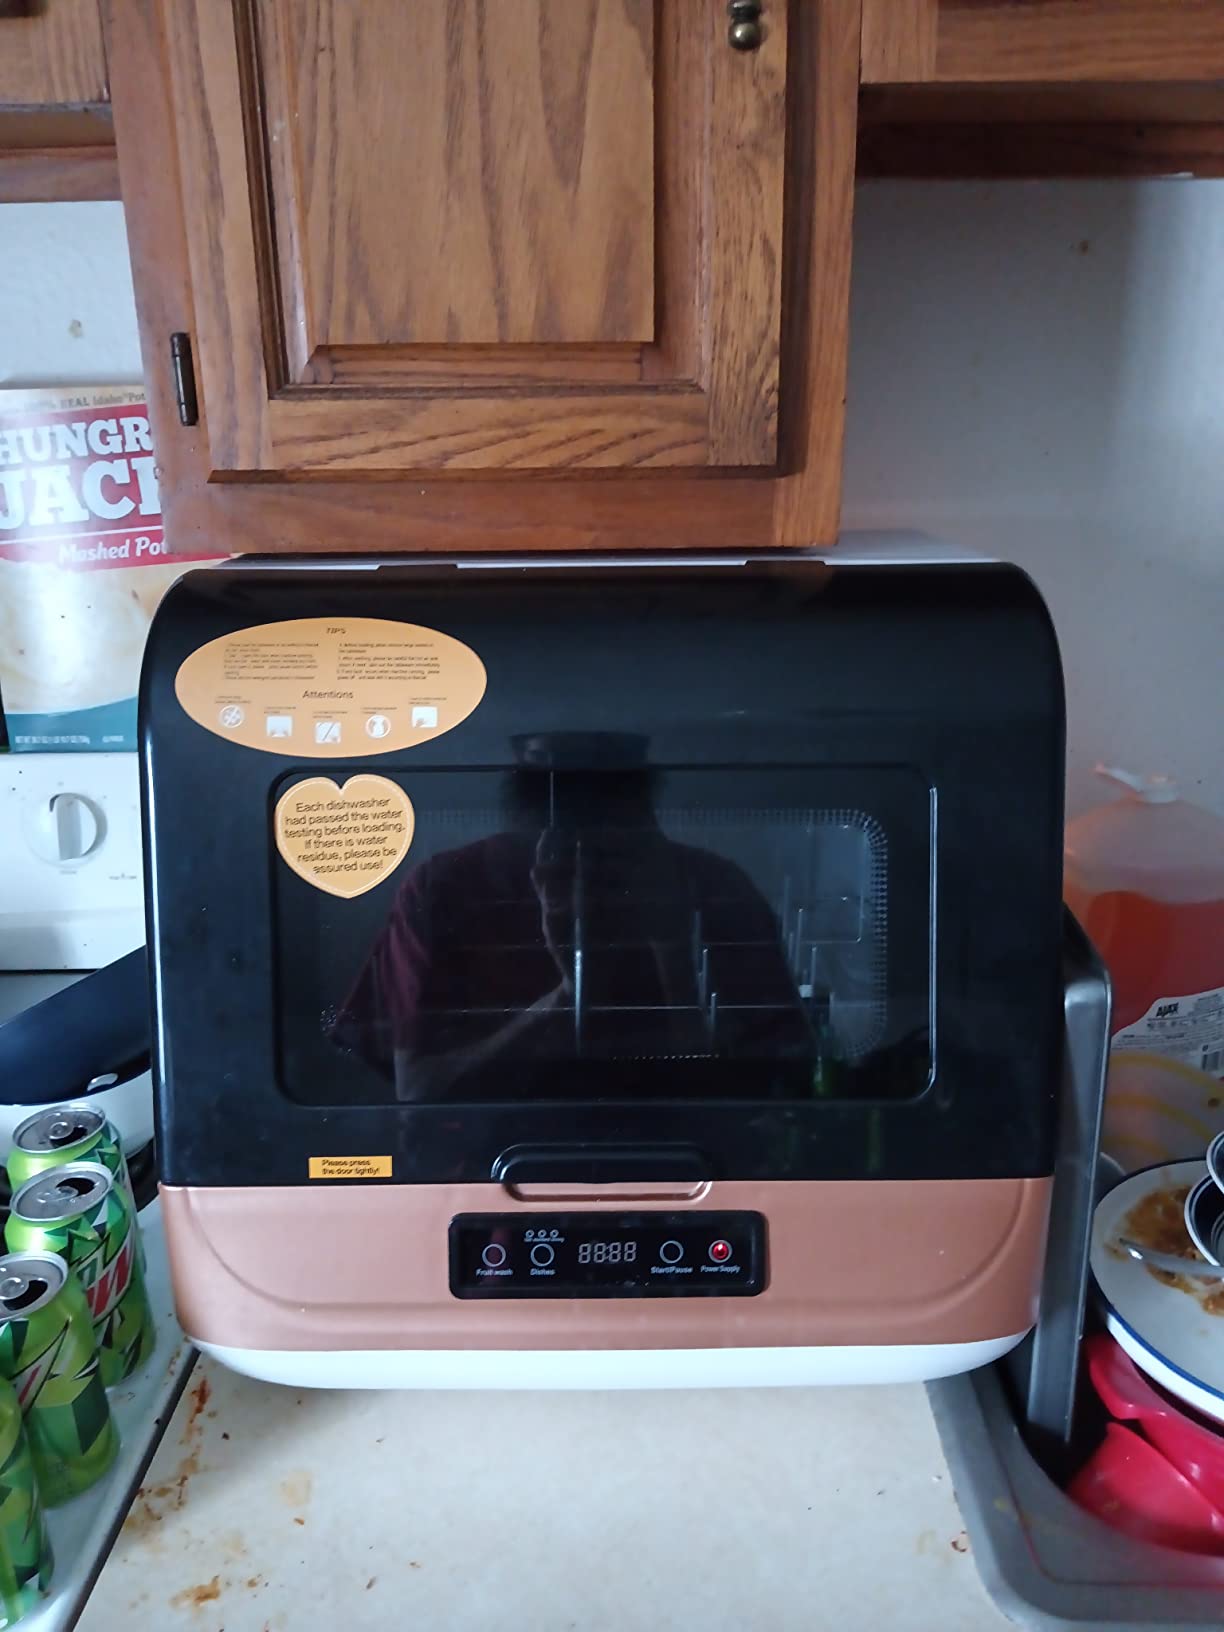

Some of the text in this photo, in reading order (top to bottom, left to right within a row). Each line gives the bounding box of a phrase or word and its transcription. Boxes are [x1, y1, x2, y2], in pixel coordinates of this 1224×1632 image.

[59, 538, 130, 562] Mashed
[302, 690, 354, 699] Attentions
[296, 797, 391, 813] Each dishwasher
[285, 809, 403, 826] had passed the water
[284, 827, 322, 839] testing
[324, 825, 360, 836] before
[305, 836, 388, 849] If there is water
[297, 846, 397, 863] residue, please be
[313, 859, 384, 874] assured use!
